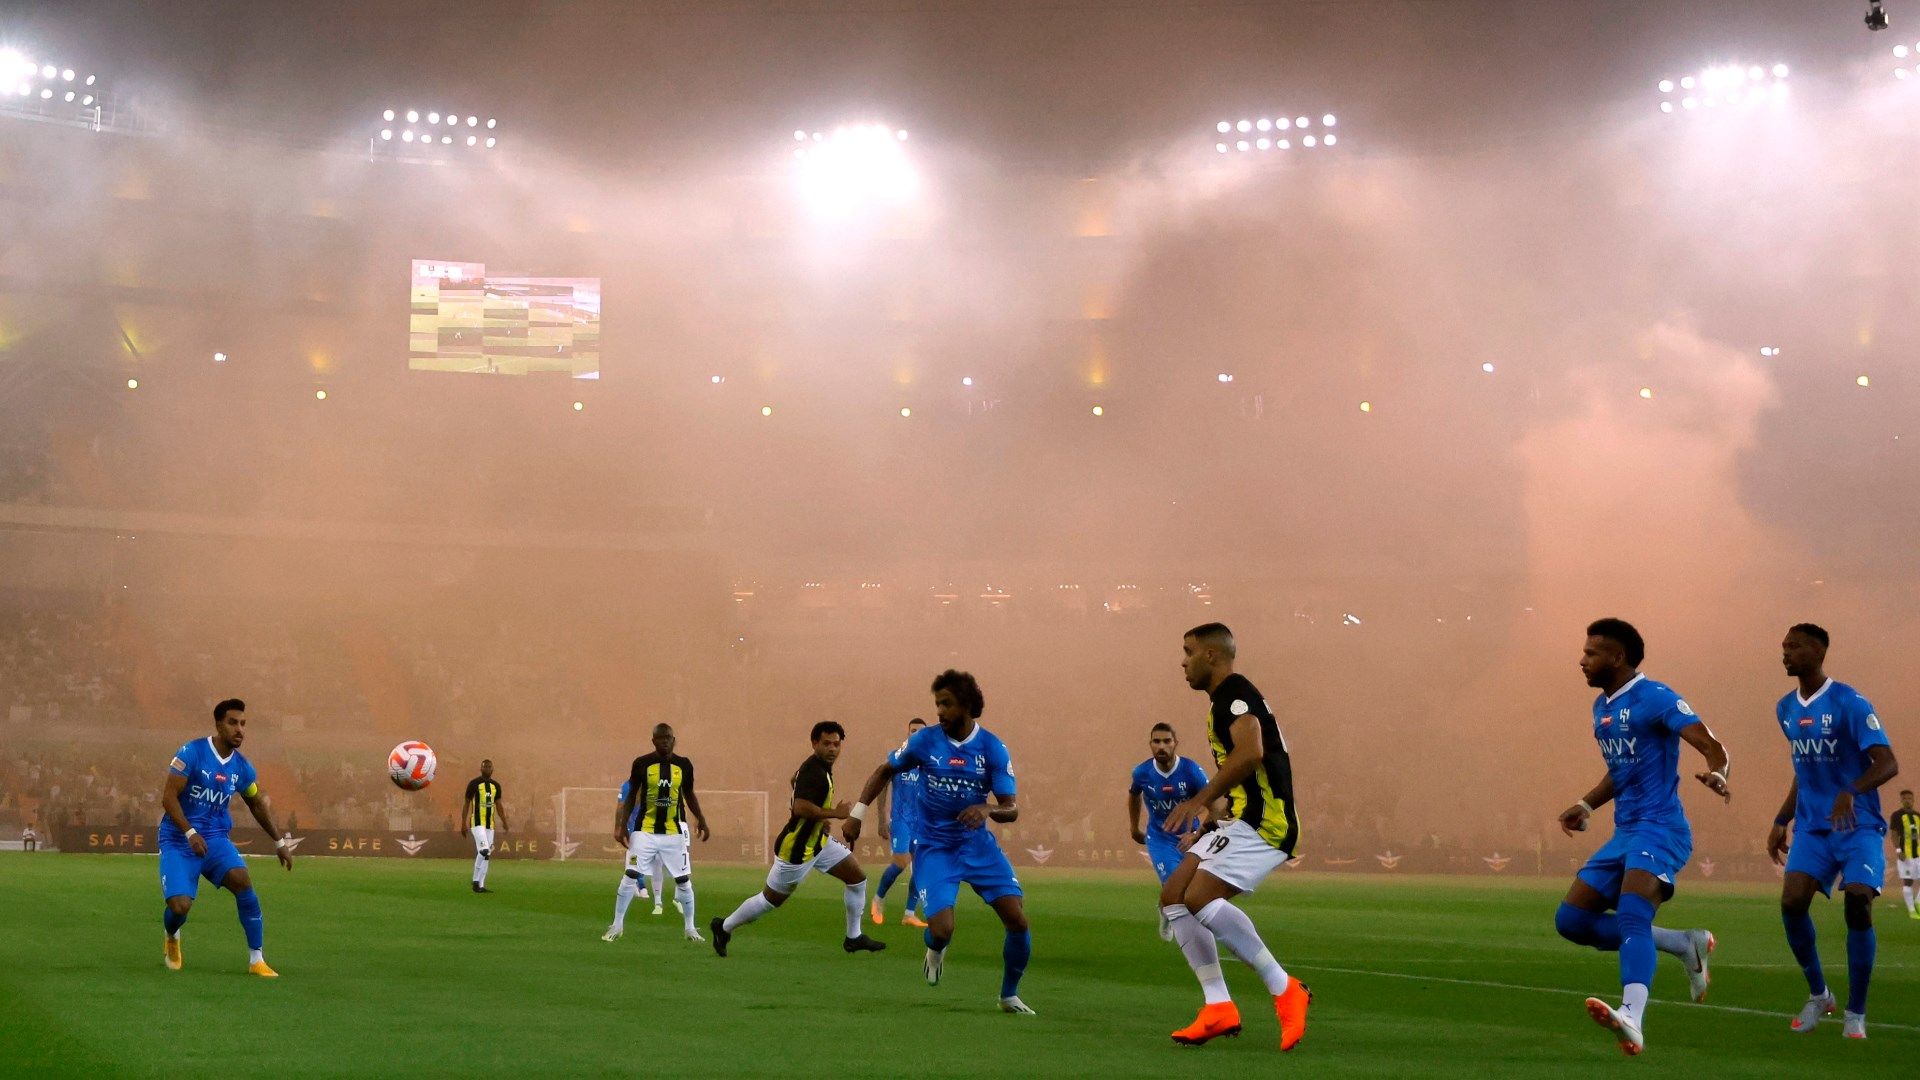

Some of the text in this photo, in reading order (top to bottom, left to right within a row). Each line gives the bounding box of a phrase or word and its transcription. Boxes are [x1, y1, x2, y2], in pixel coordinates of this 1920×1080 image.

[1792, 739, 1838, 755] AVVY
[901, 772, 919, 782] SAV
[189, 785, 232, 804] SAVV
[89, 834, 144, 847] SAFE
[329, 837, 381, 850] SAFE
[493, 840, 537, 852] AFE
[1206, 835, 1230, 854] 99
[741, 843, 762, 856] FE
[861, 845, 885, 857] SA
[1077, 849, 1126, 861] SAFE
